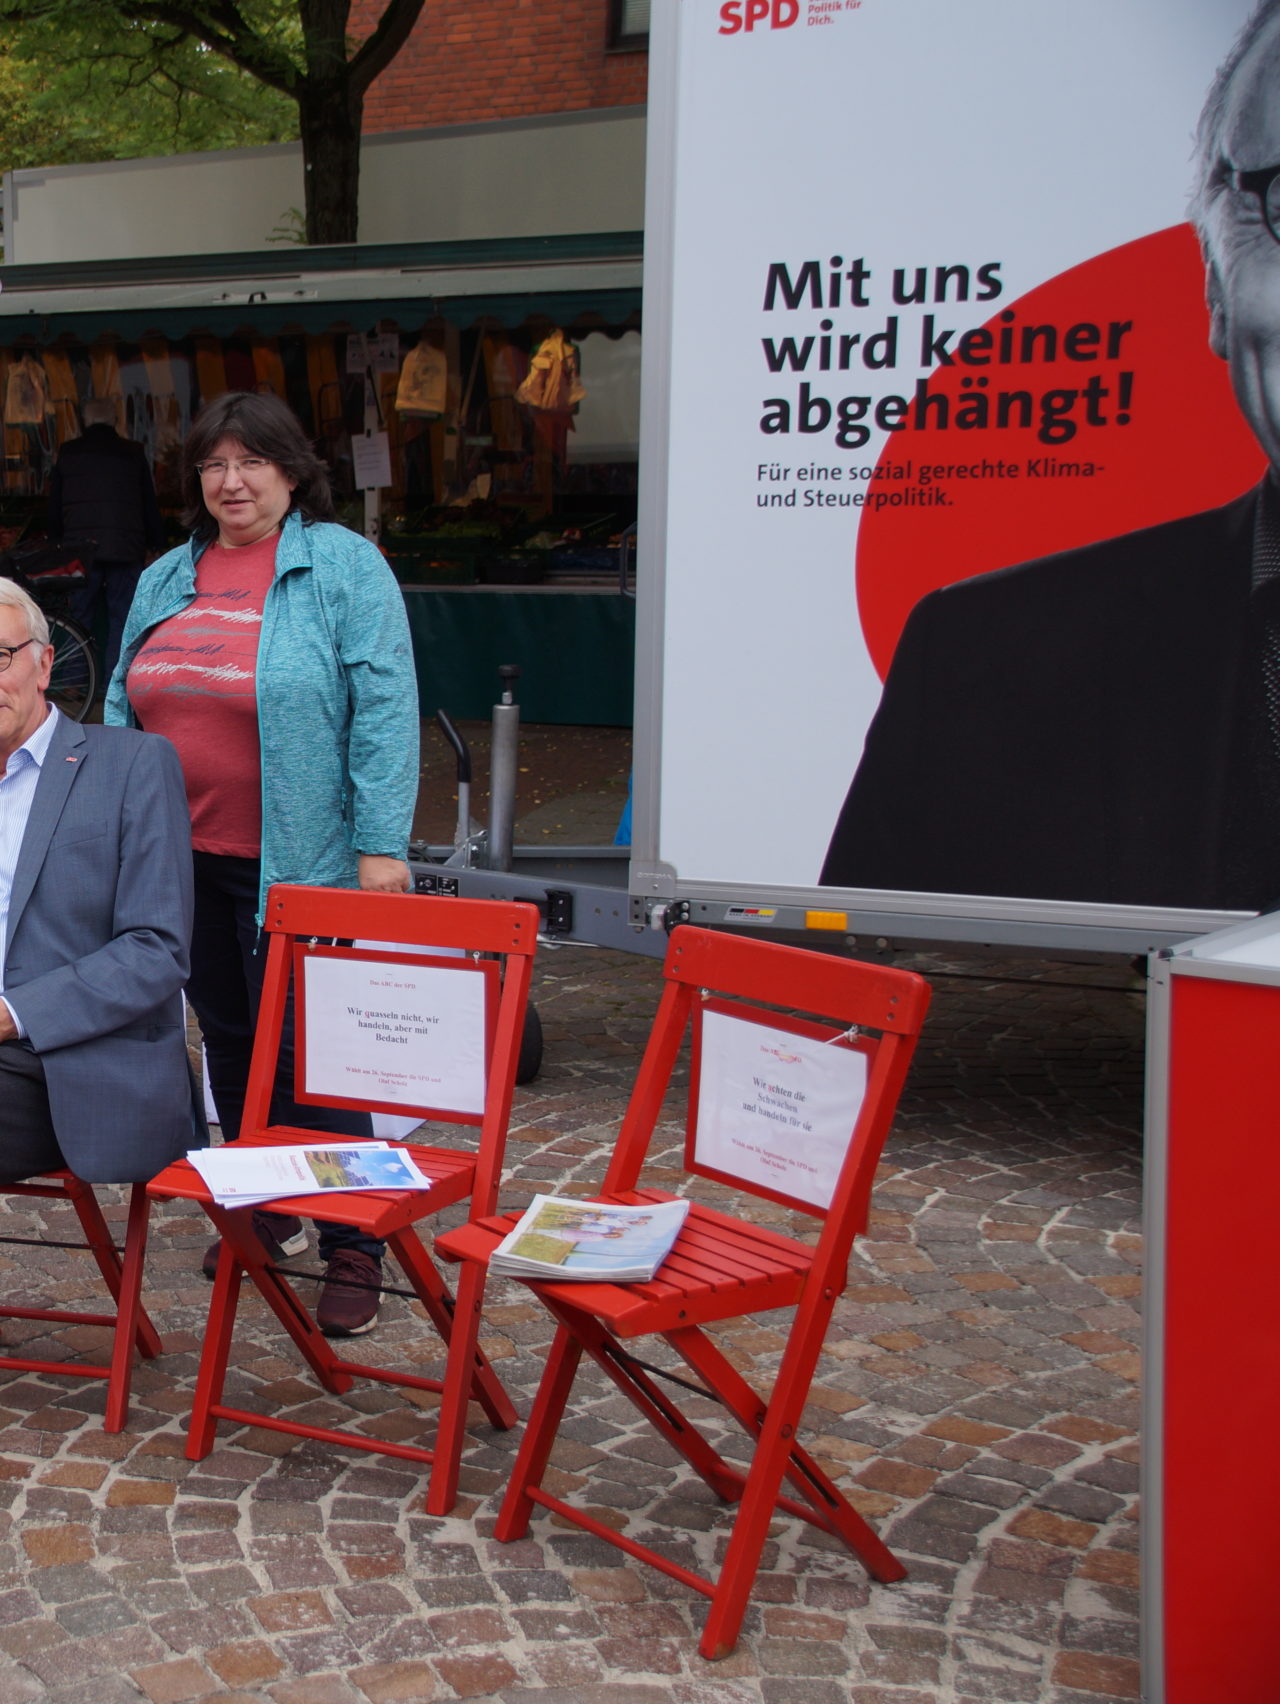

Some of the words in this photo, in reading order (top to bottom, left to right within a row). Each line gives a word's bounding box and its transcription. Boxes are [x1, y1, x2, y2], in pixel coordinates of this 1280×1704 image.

[718, 0, 799, 35] SPD
[808, 3, 842, 14] Politik
[845, 0, 861, 10] für
[807, 15, 834, 26] Dich.
[763, 255, 871, 311] Mit
[892, 260, 1003, 306] uns
[762, 316, 899, 373] wird
[920, 309, 1133, 368] keiner
[759, 371, 1135, 450] abgehängt!
[756, 462, 791, 483] Für
[796, 465, 842, 482] eine
[847, 460, 913, 481] sozial
[918, 459, 1020, 486] gerechte
[1026, 457, 1105, 479] Klima-
[755, 487, 797, 508] und
[803, 486, 954, 512] Steuerpolitik.
[347, 1007, 362, 1016] Wir
[365, 1010, 398, 1020] quasseln
[401, 1013, 423, 1023] nicht,
[426, 1015, 439, 1024] wir
[358, 1019, 392, 1031] handeln,
[395, 1024, 412, 1033] aber
[415, 1026, 428, 1035] mit
[375, 1033, 408, 1044] Bedacht
[757, 1094, 798, 1113] Schwachen
[794, 1092, 805, 1101] die
[742, 1102, 756, 1114] und
[759, 1105, 787, 1124] handeln
[790, 1117, 800, 1127] für
[803, 1122, 812, 1132] sie
